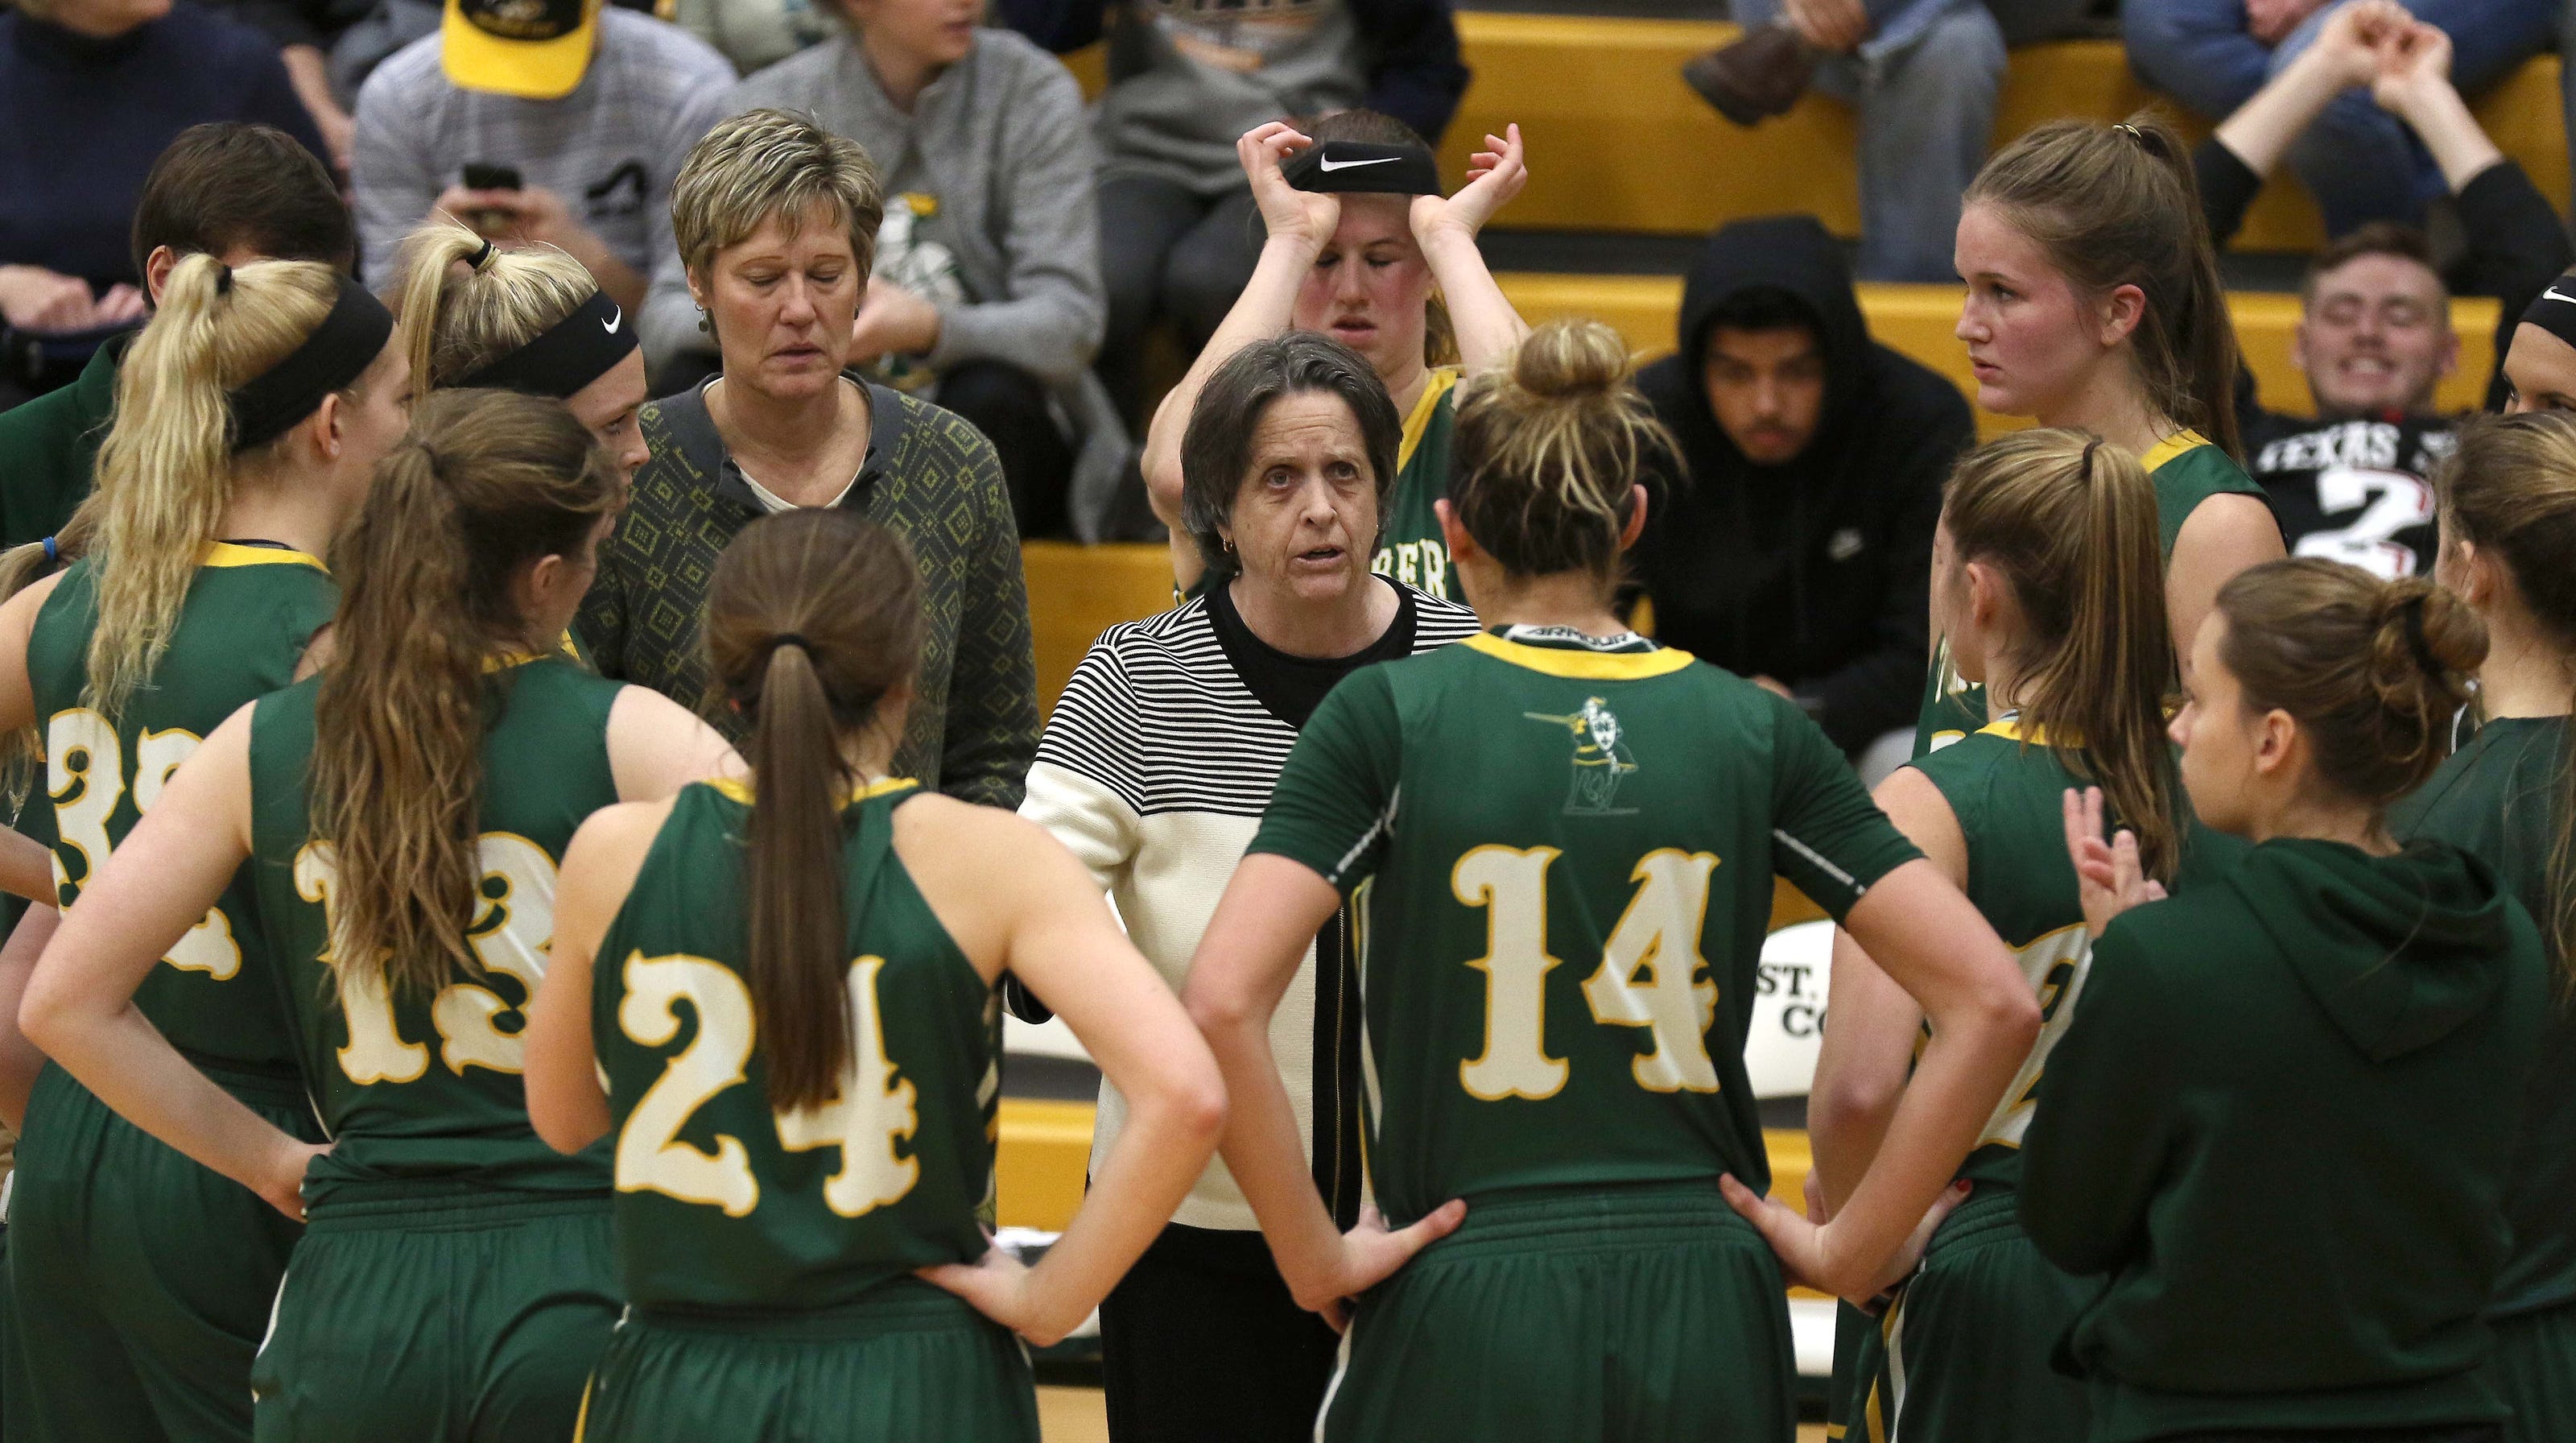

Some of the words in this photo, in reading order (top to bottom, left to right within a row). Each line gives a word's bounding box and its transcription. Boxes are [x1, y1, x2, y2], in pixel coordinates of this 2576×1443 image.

[293, 830, 562, 1085] 13
[614, 948, 920, 1218] 24
[1451, 843, 1723, 1101] 14
[1756, 964, 1818, 999] ST.
[1781, 1005, 1827, 1037] C
